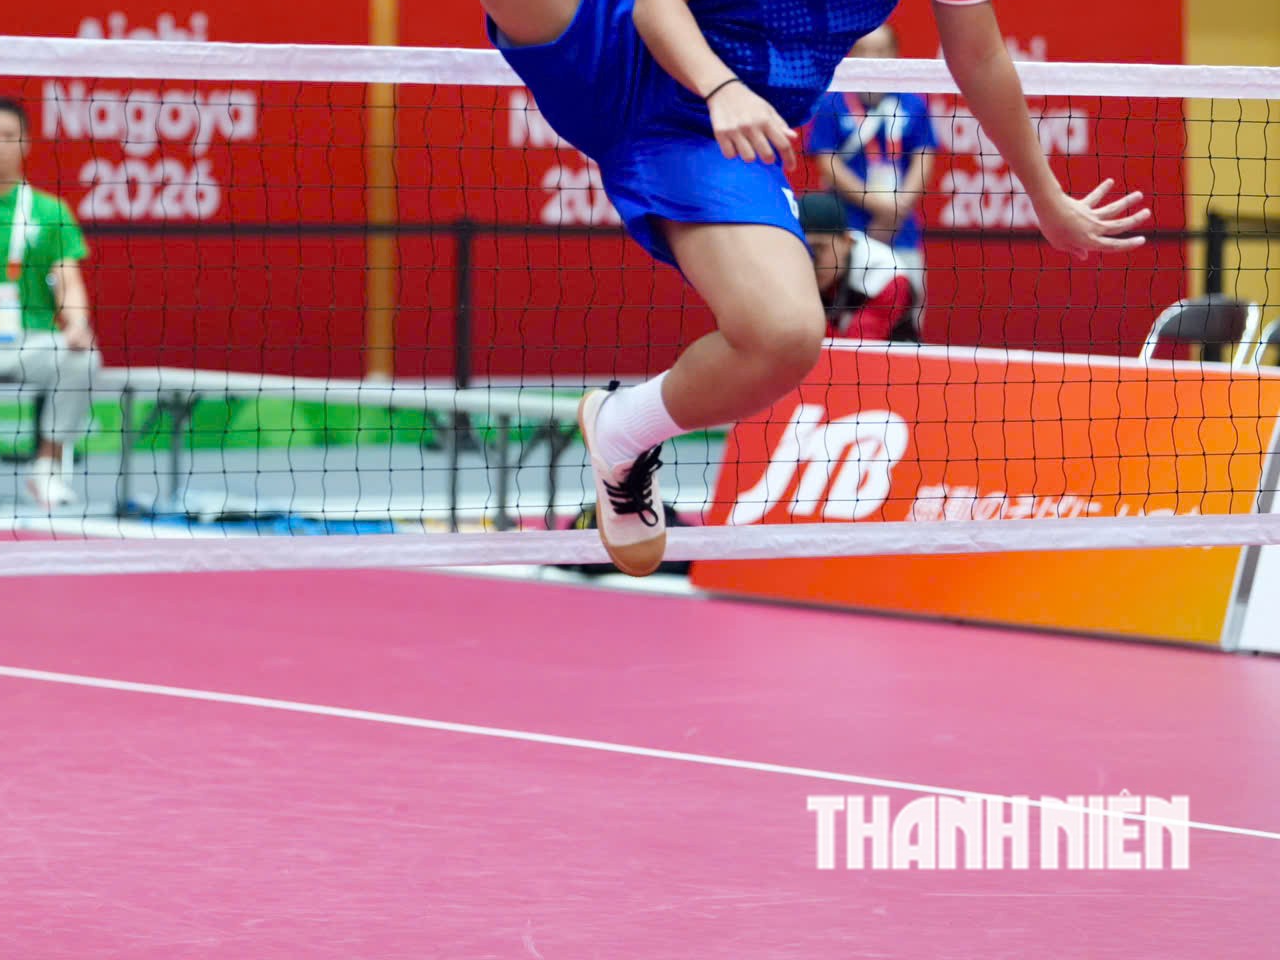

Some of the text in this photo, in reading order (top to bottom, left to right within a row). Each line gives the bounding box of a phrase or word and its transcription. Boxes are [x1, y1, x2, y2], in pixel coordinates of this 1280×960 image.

[42, 80, 257, 156] Nagoya
[77, 159, 220, 219] 2026
[725, 403, 910, 526] JTB
